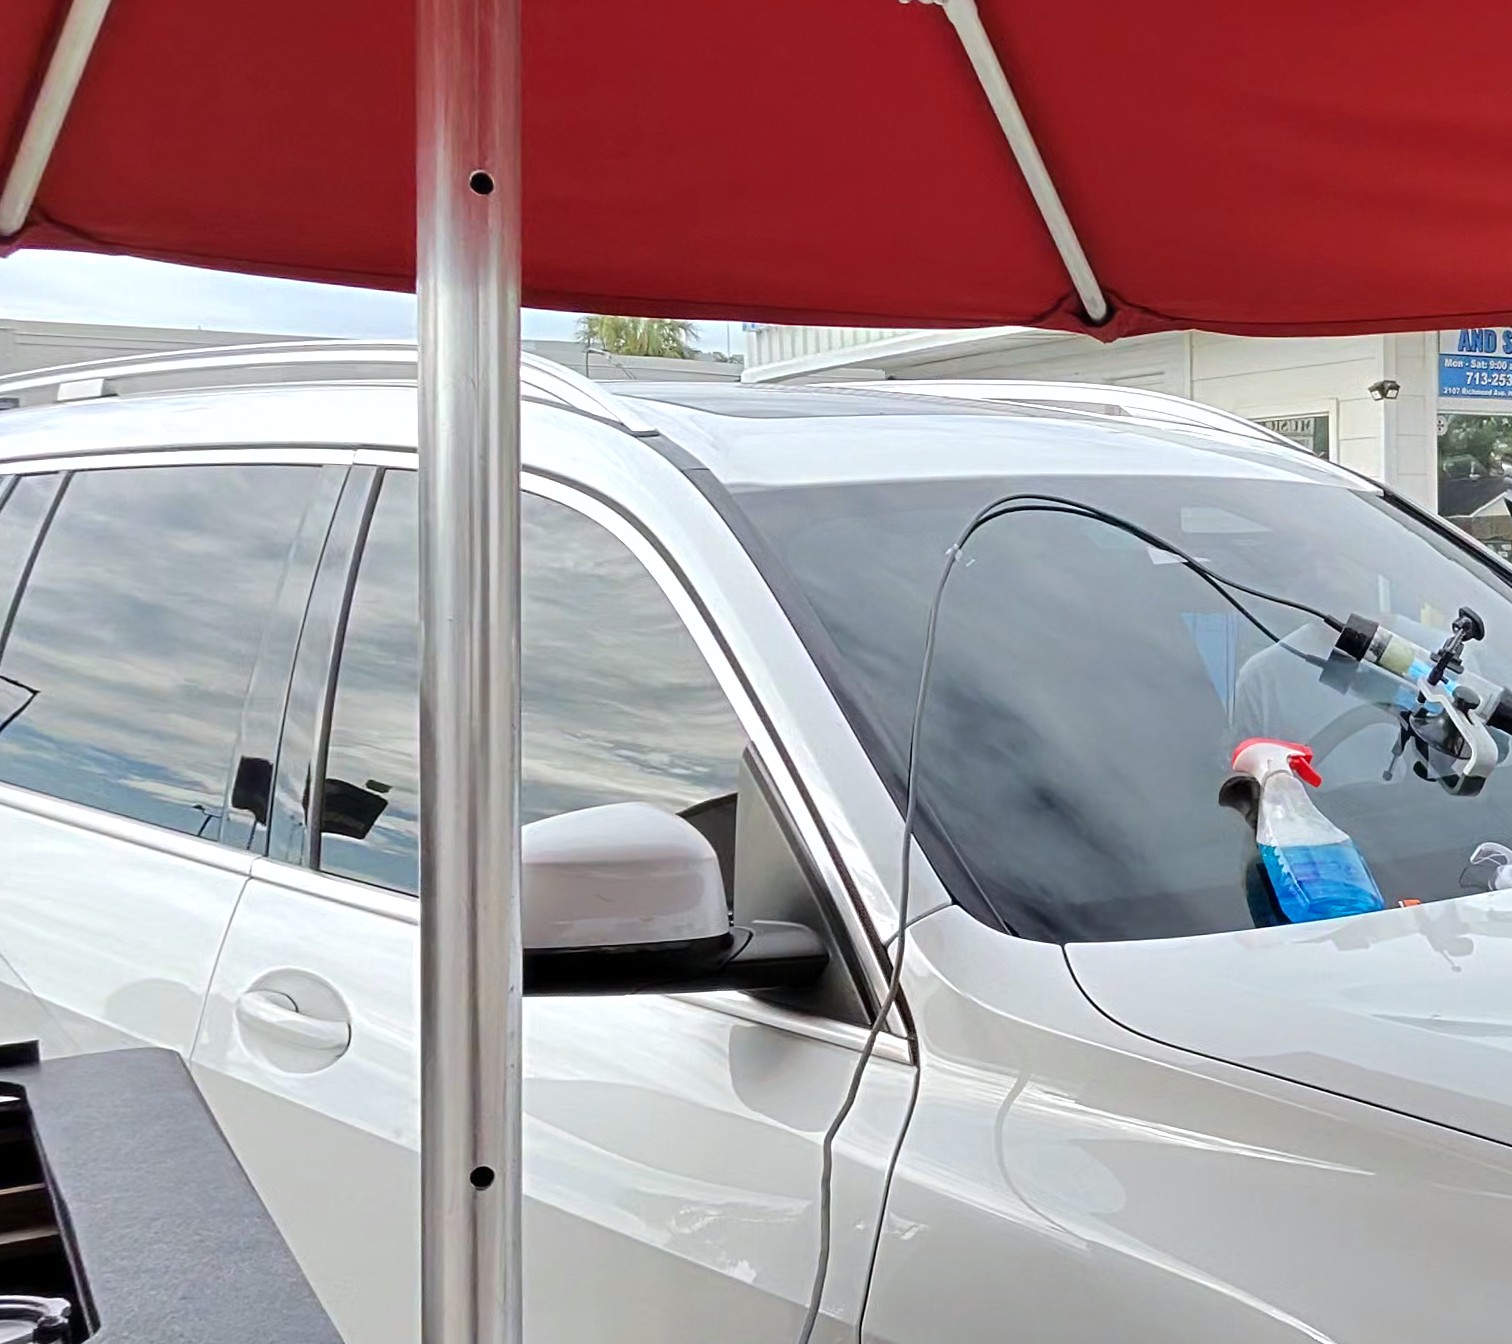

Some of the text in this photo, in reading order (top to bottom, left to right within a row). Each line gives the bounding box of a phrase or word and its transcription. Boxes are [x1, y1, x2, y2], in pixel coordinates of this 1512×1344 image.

[1458, 328, 1497, 353] AND
[1444, 358, 1463, 368] Mon
[1443, 387, 1460, 395] 2107
